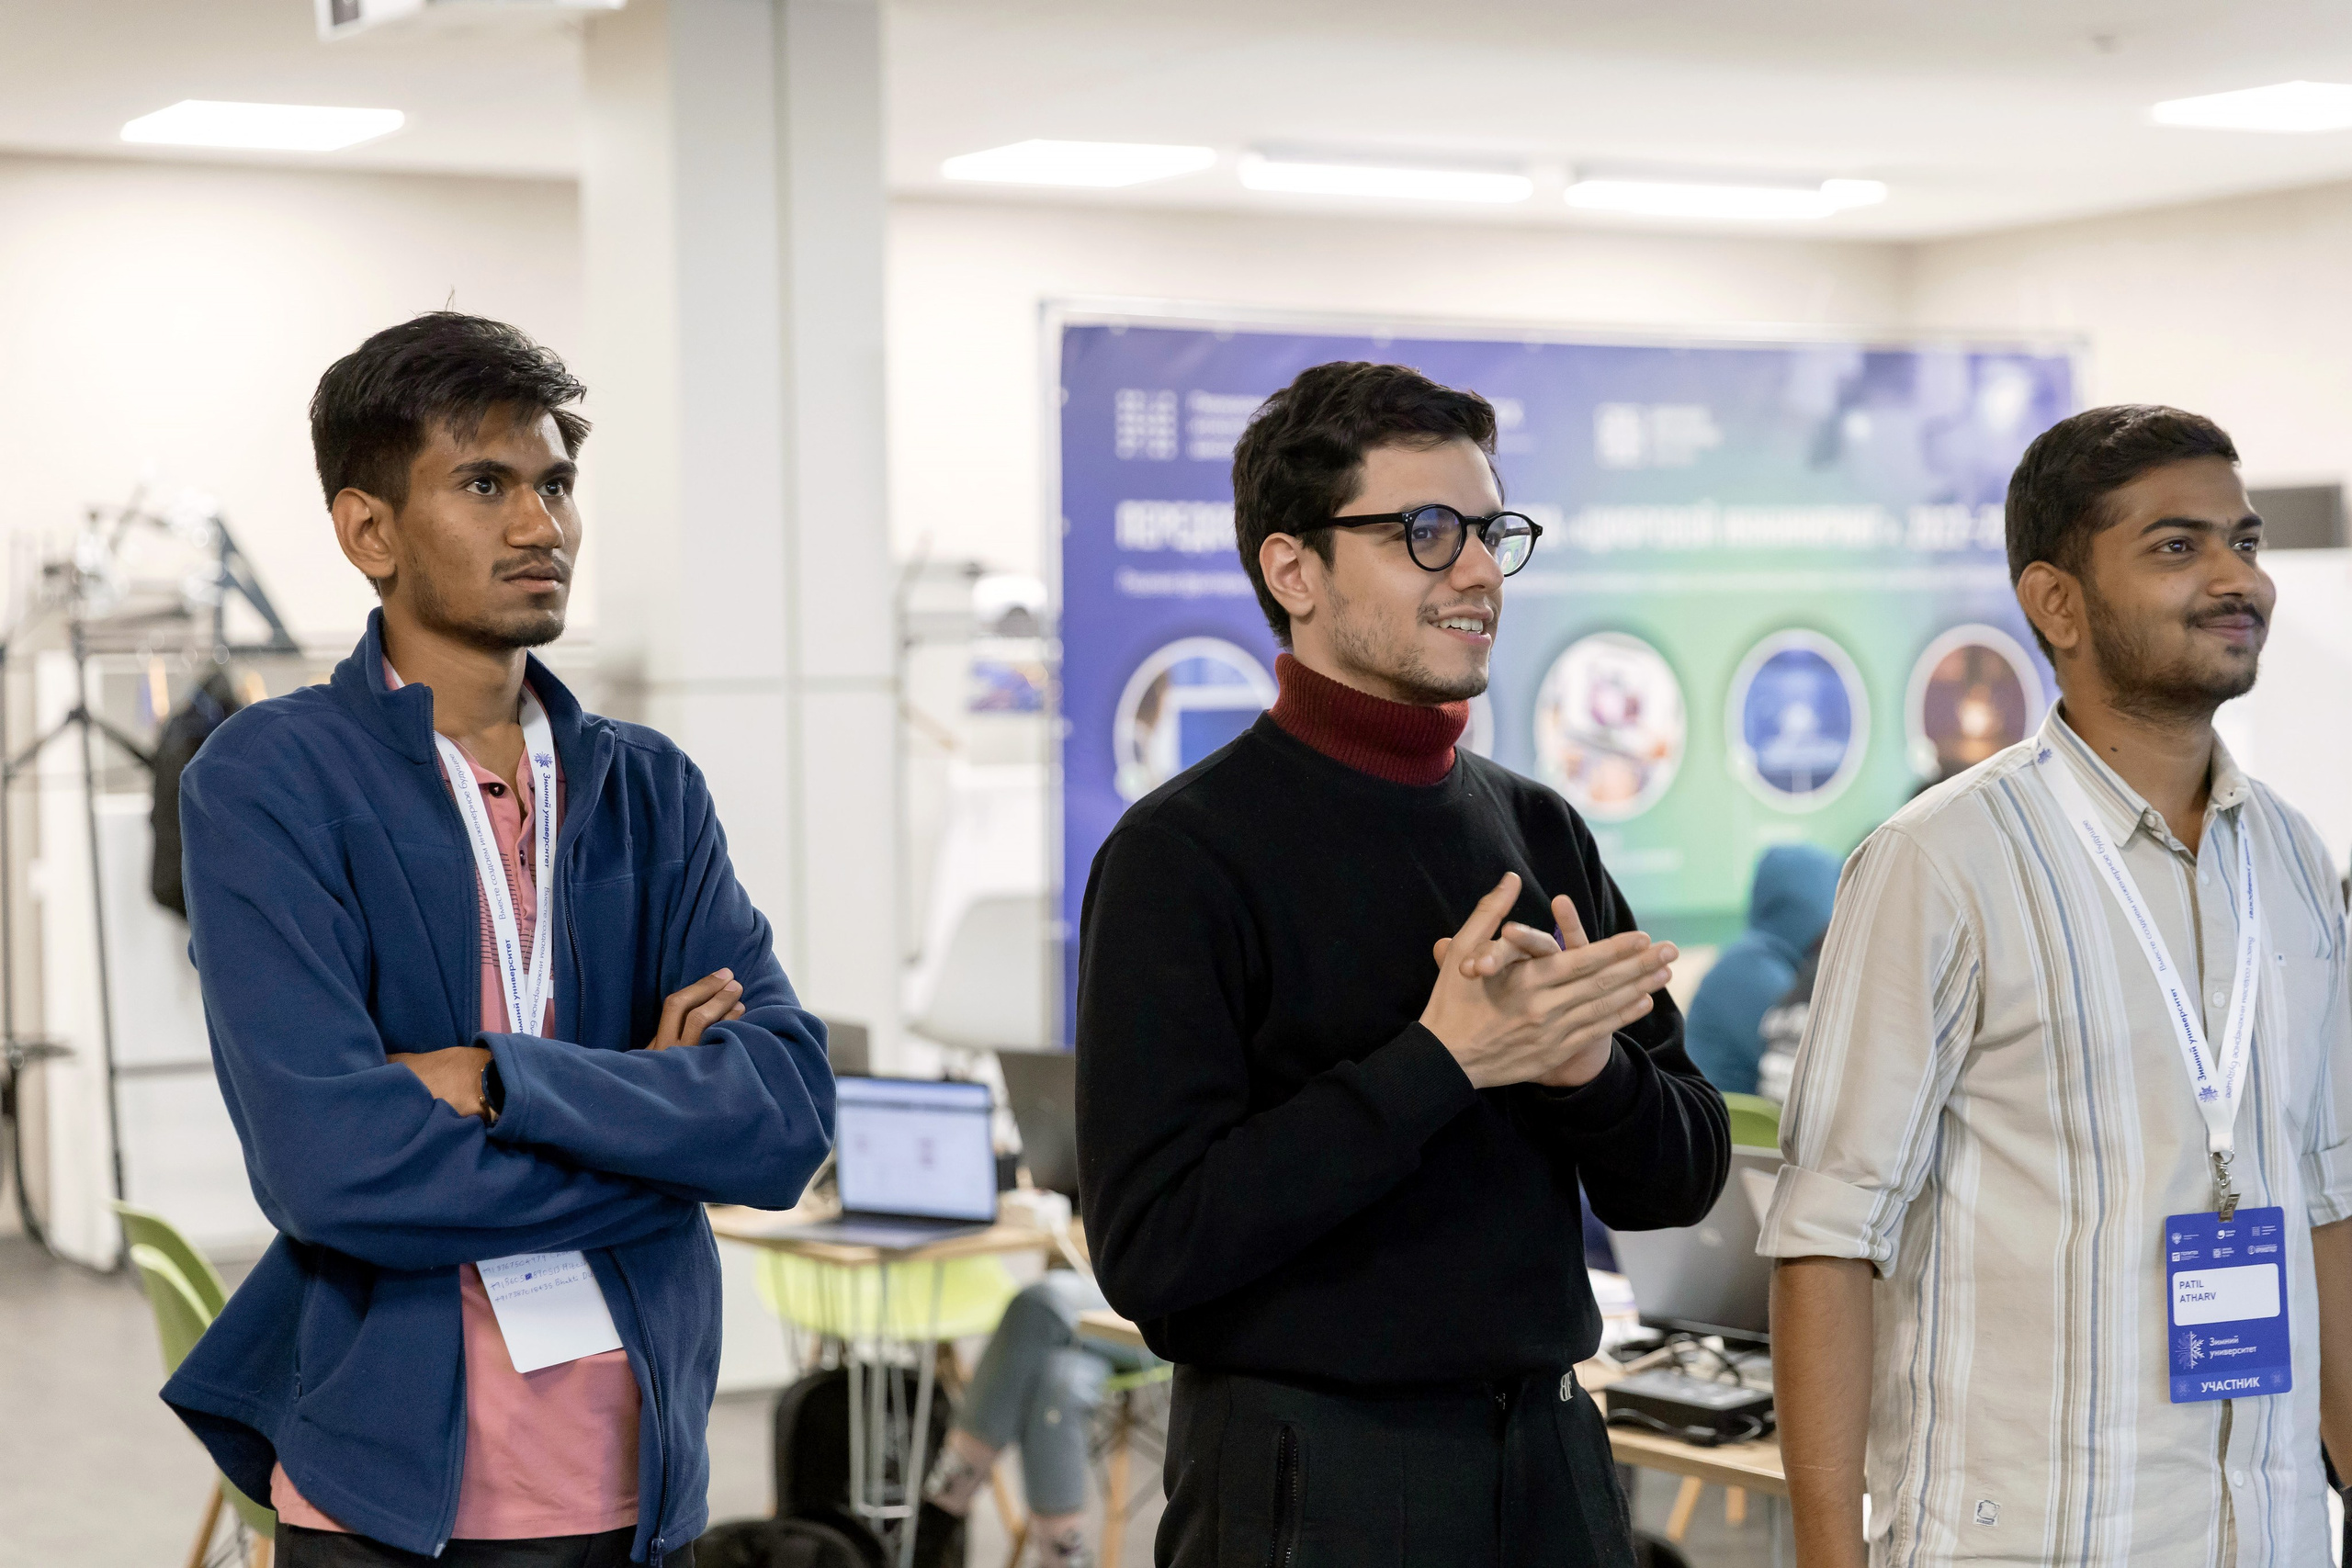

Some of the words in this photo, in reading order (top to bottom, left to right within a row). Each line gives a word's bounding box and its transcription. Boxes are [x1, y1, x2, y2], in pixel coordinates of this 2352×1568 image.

[543, 773, 551, 808] Зимний
[464, 791, 486, 846] инженерное
[505, 940, 520, 1000] университет
[531, 961, 544, 1018] инженерное
[513, 1003, 525, 1033] имний
[2170, 987, 2198, 1044] университет
[2188, 1045, 2207, 1081] Зимний
[2179, 1280, 2204, 1289] PATIL
[2180, 1292, 2216, 1303] ATHARV
[2210, 1336, 2239, 1346] Зимний
[2210, 1347, 2257, 1359] университет
[2201, 1377, 2260, 1393] УЧАСТНИК
